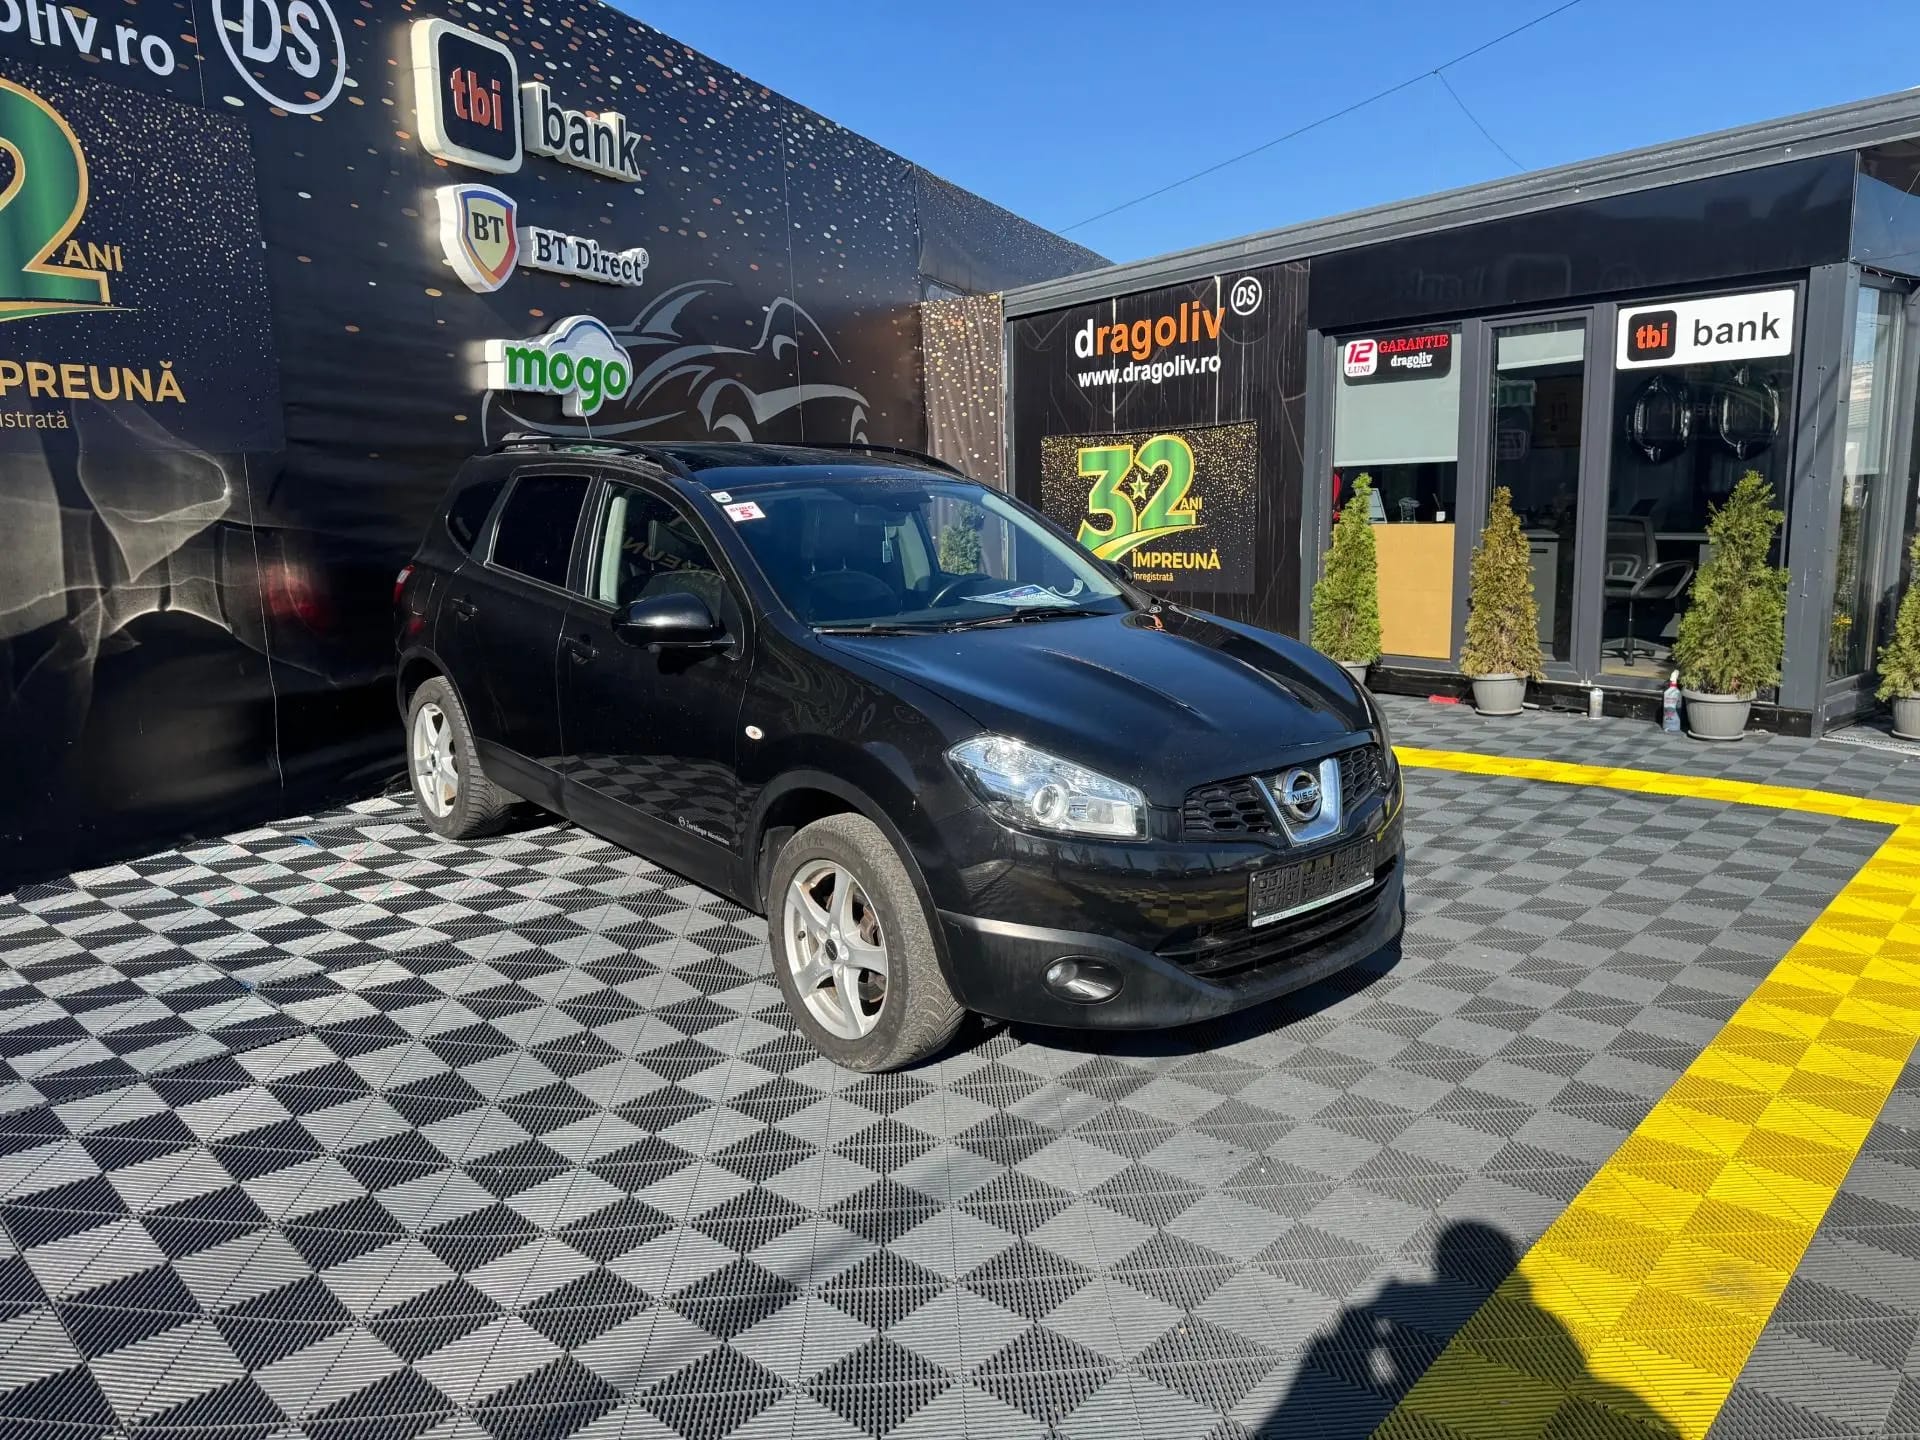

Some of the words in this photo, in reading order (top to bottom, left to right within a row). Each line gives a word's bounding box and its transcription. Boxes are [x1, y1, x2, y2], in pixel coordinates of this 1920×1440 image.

[242, 0, 321, 78] DS
[450, 67, 503, 131] tbi
[540, 89, 641, 178] bank
[472, 212, 504, 244] BT
[62, 240, 124, 272] ANI
[535, 231, 568, 266] BT
[1235, 286, 1256, 308] DS
[1075, 301, 1226, 361] dragoliv
[1636, 322, 1670, 350] tbi
[1693, 311, 1780, 347] bank
[1348, 342, 1374, 364] 12
[1379, 334, 1449, 353] GARANTIE
[1390, 352, 1433, 368] dragoliv
[506, 345, 626, 411] mogo
[1078, 355, 1222, 388] www.dragoliv.ro
[1348, 365, 1370, 374] LUNI
[1077, 434, 1195, 554] 32
[1180, 497, 1203, 510] ANI
[1132, 547, 1221, 570] ÎMPREUNĂ
